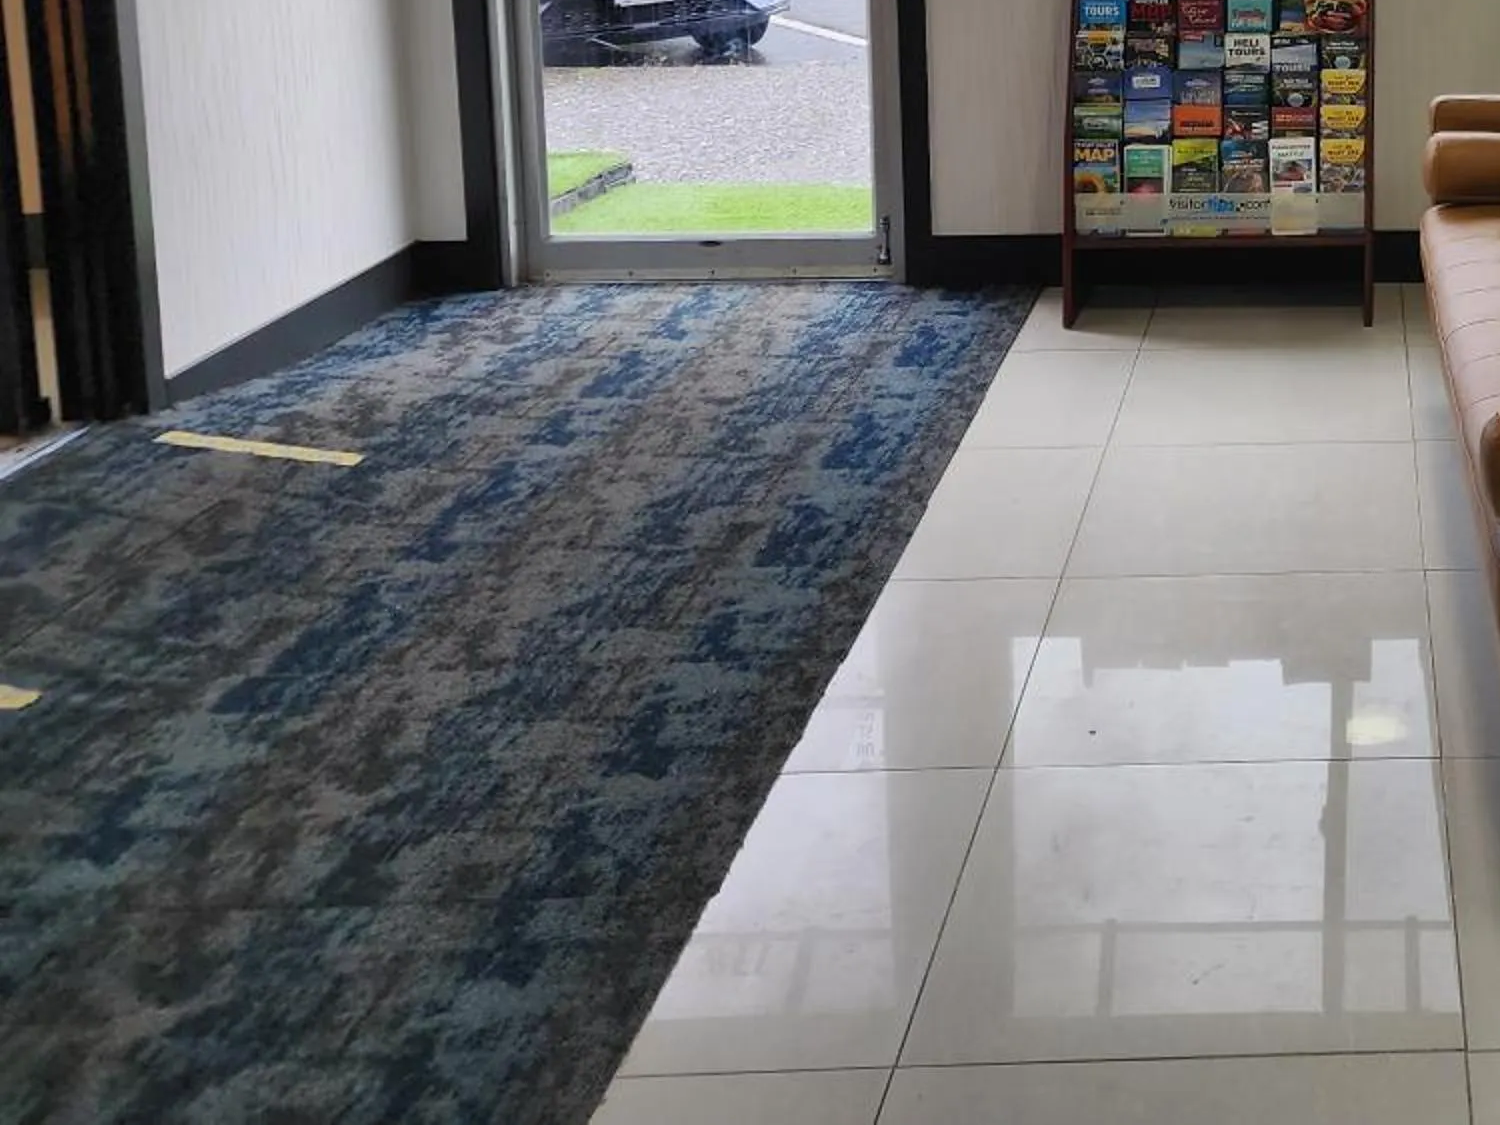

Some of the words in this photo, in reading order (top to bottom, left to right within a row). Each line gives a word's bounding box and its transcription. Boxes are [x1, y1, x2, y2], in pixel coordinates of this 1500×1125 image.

[1083, 5, 1120, 17] TOURS
[1233, 39, 1259, 47] HELI
[1228, 48, 1266, 56] TOURS
[1074, 148, 1115, 162] MAP
